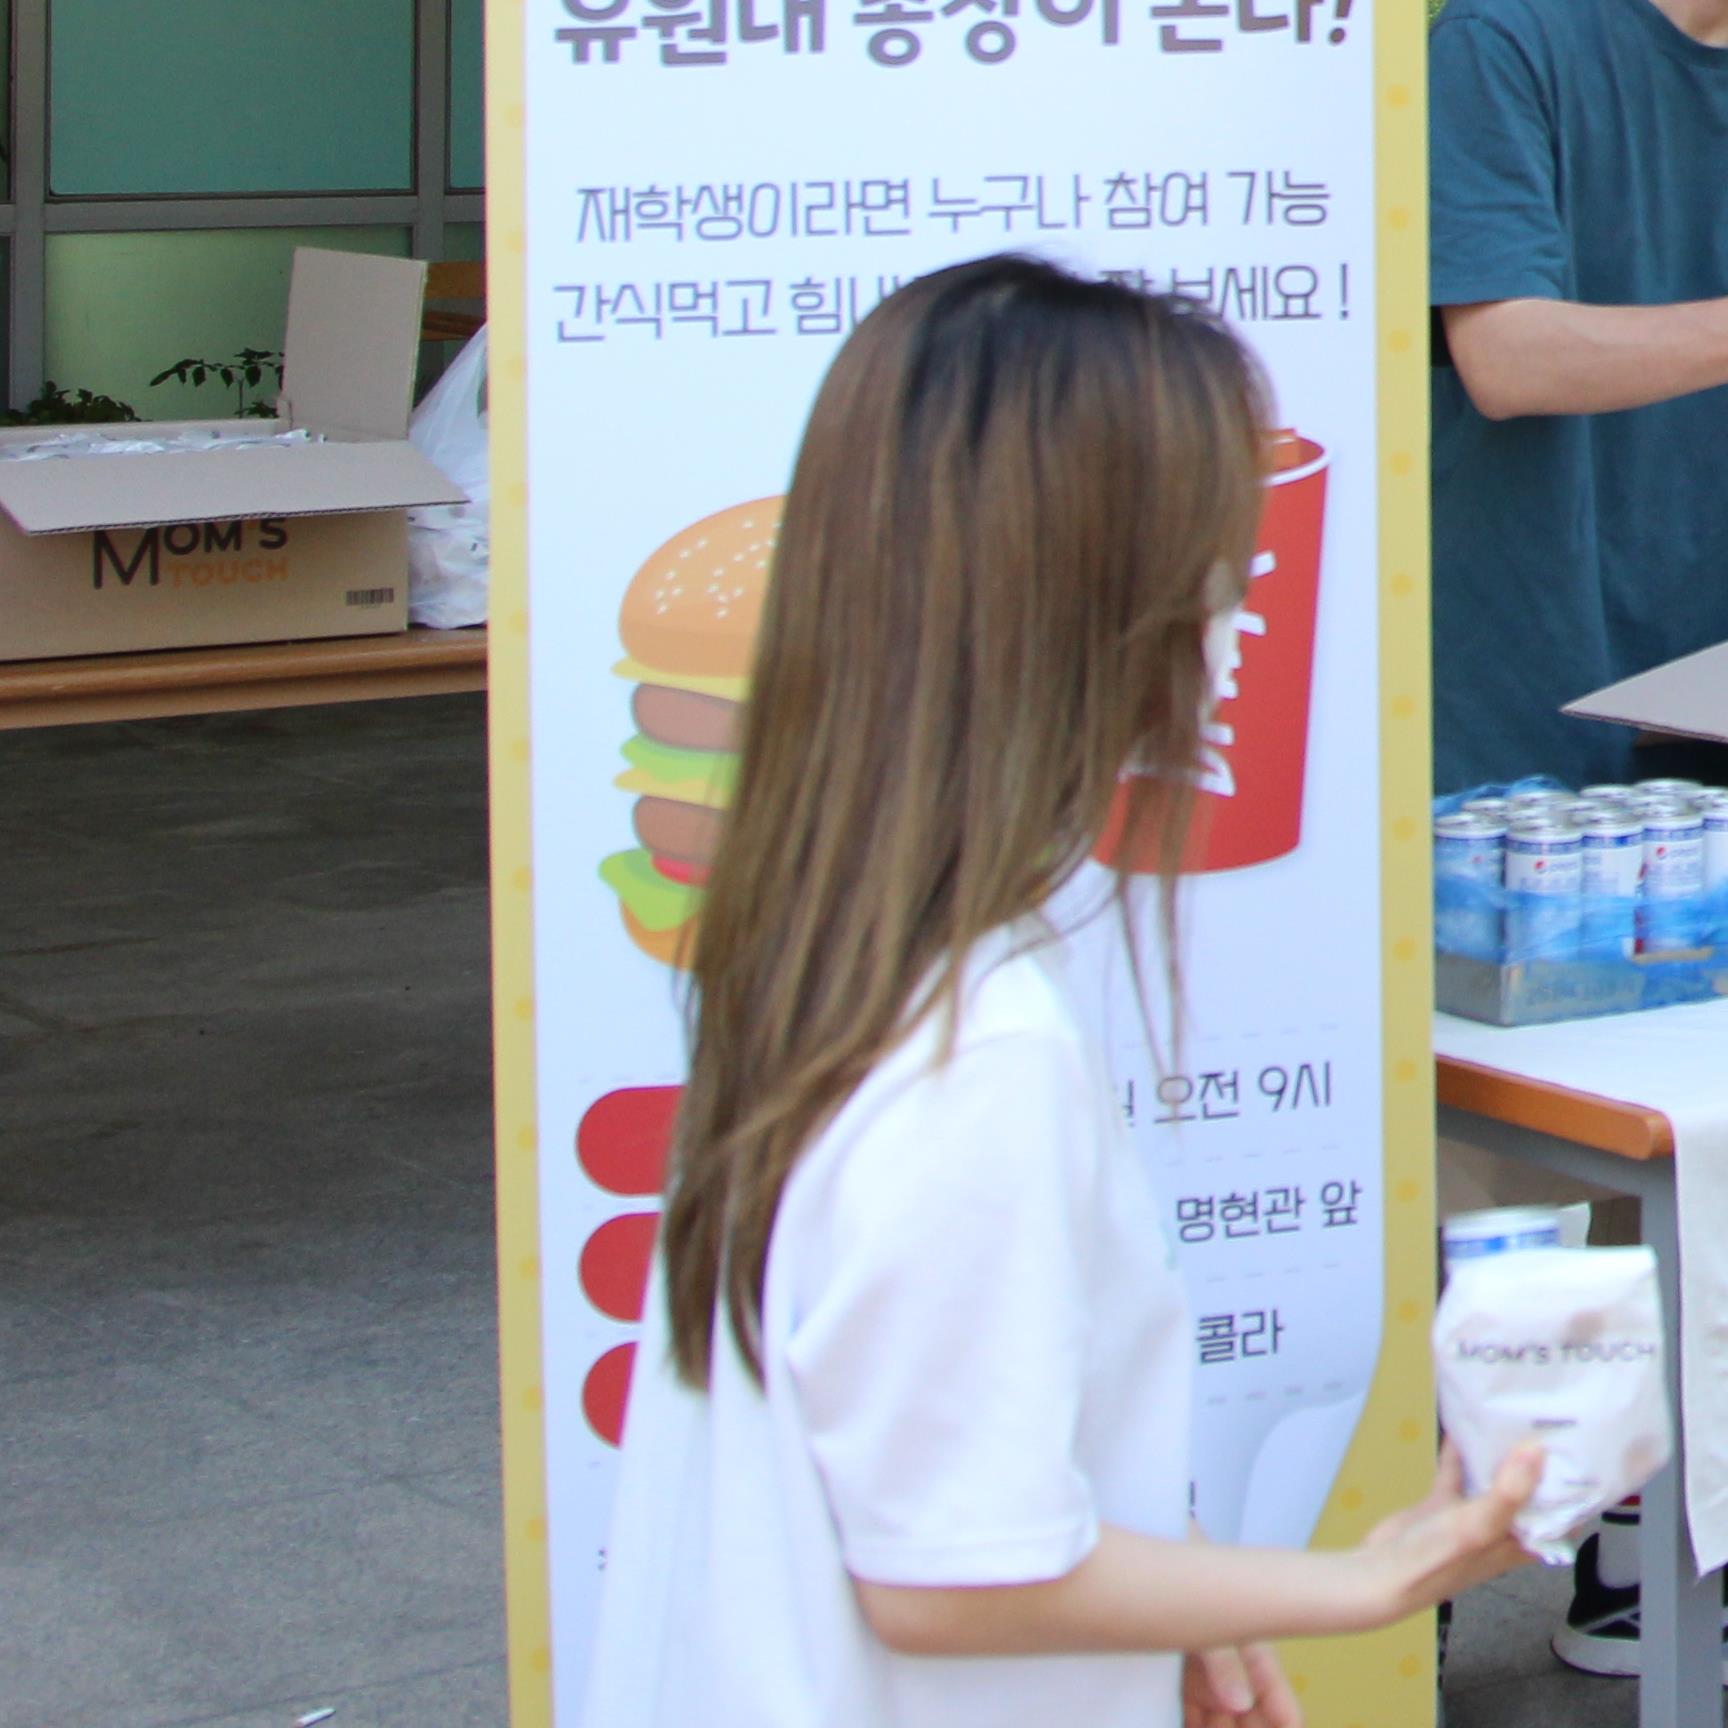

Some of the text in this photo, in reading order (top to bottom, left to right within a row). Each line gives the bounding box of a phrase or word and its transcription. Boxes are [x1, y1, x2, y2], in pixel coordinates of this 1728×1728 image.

[576, 170, 1331, 243] 재학생이라면 누구나 참여 가능
[552, 279, 778, 343] 간식먹고
[165, 557, 289, 589] TOUCH
[1154, 1070, 1240, 1124] 오전
[1257, 1060, 1332, 1112] 9시
[1176, 1180, 1363, 1244] 명현관 앞
[1195, 1308, 1285, 1364] 콜라
[1561, 1339, 1656, 1362] TOUCH
